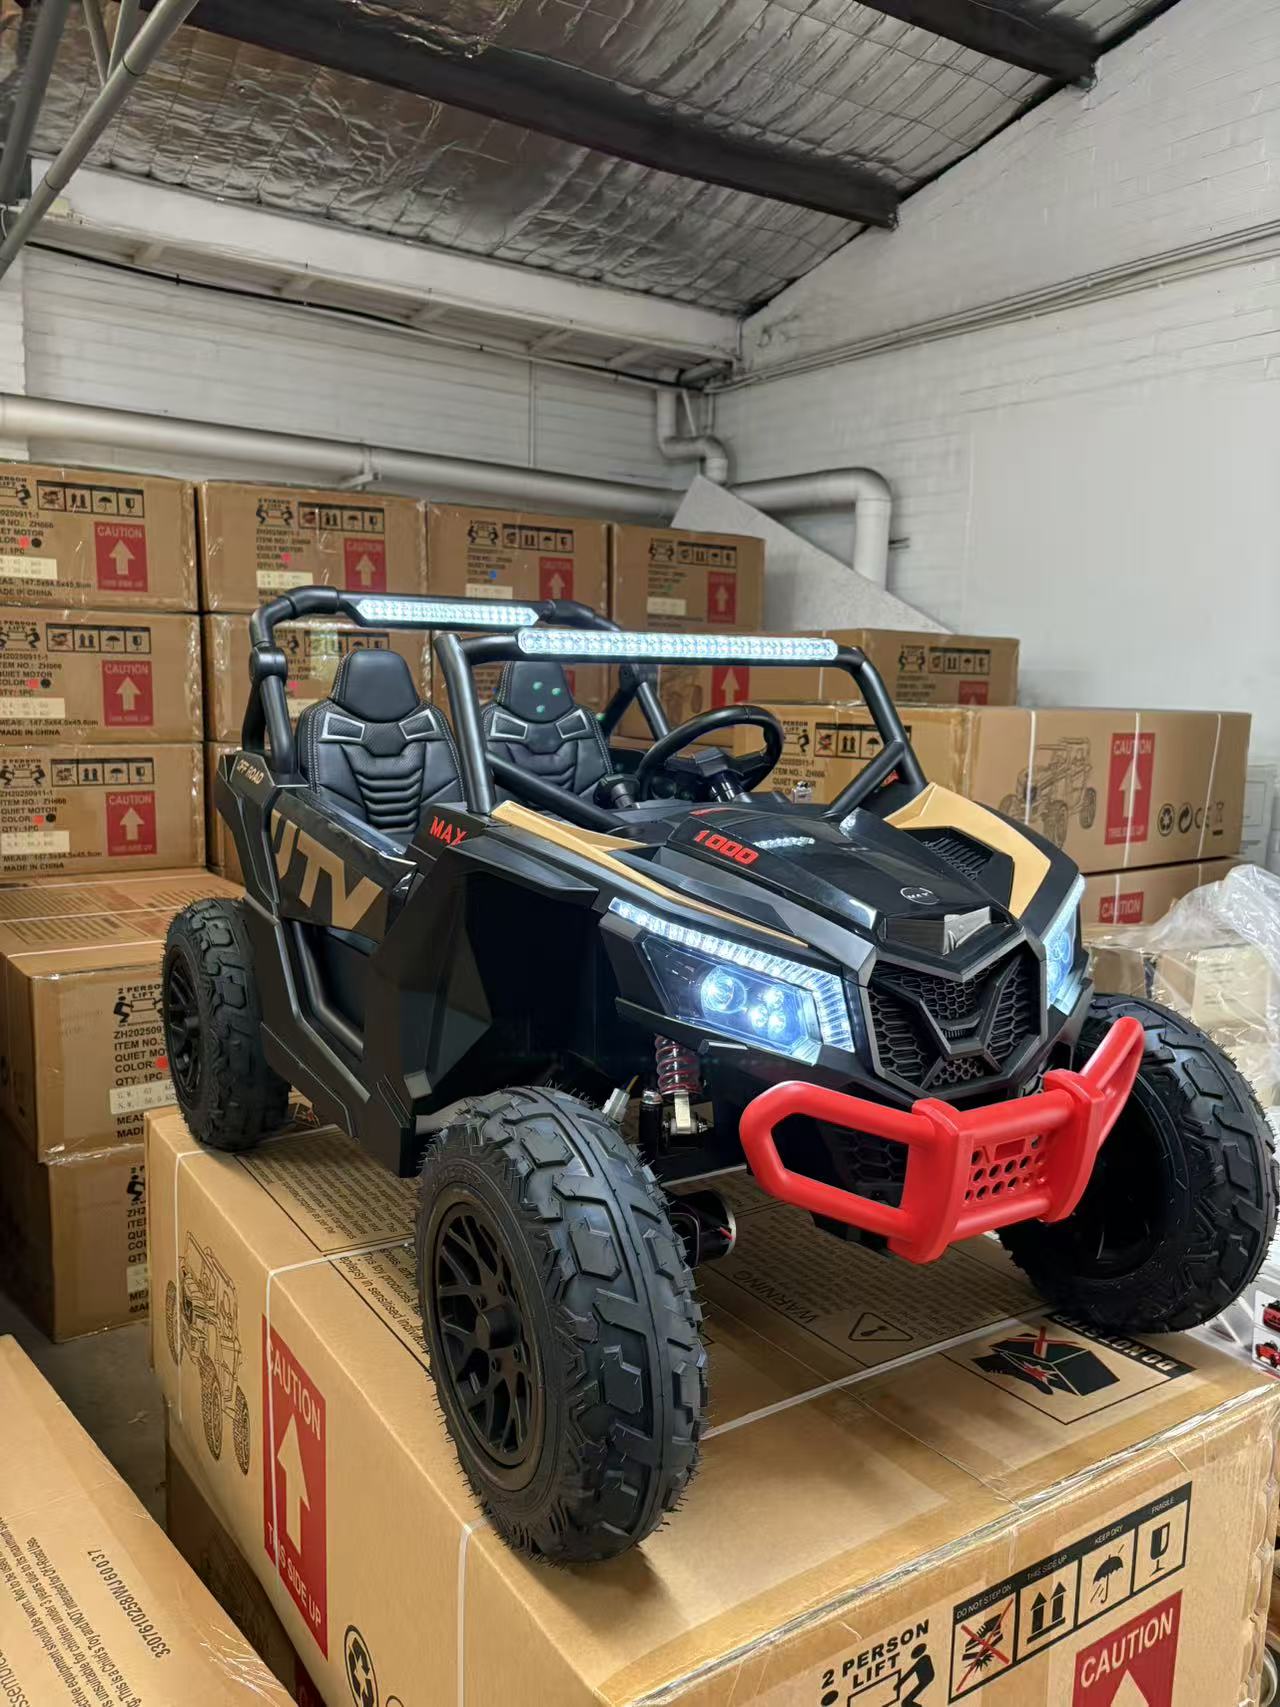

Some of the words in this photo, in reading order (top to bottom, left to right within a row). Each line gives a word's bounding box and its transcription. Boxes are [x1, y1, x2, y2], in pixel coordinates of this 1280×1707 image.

[14, 529, 44, 537] MOTOR
[98, 527, 143, 539] CAUTION
[27, 589, 53, 597] CHINA
[105, 663, 149, 674] CAUTION
[1, 729, 23, 737] MADE
[25, 729, 34, 737] IN
[237, 759, 249, 772] OFF
[246, 766, 264, 784] ROAD
[1, 798, 20, 806] ITEM
[109, 794, 151, 805] CAUTION
[28, 806, 58, 814] MOTOR
[429, 816, 468, 847] MAX
[694, 830, 759, 866] 1000
[4, 864, 28, 872] MADE
[29, 863, 38, 871] IN
[39, 862, 64, 870] CHINA
[127, 983, 161, 994] PERSO
[132, 991, 154, 999] LIFT
[114, 1039, 139, 1051] ITEM
[115, 1051, 147, 1063] QUIET
[115, 1060, 156, 1074] COLOR:
[115, 1077, 141, 1088] QTY:
[143, 1071, 163, 1082] 1PC
[116, 1113, 145, 1126] MEAS
[339, 1256, 366, 1279] epilepsy
[362, 1277, 373, 1287] in
[368, 1286, 402, 1319] sensitised
[372, 1262, 384, 1274] toy
[379, 1272, 415, 1303] produces
[732, 1268, 817, 1322] WARNING
[1098, 1338, 1145, 1356] NOT
[1142, 1357, 1176, 1371] DO
[266, 1344, 321, 1442] CAUTION
[1152, 1497, 1174, 1513] FRAGILE
[1095, 1531, 1110, 1544] KEEP
[1109, 1525, 1123, 1536] DRY
[16, 1556, 27, 1567] its
[1043, 1559, 1059, 1572] SIDE
[1058, 1554, 1067, 1564] UP
[5, 1572, 17, 1583] be
[25, 1571, 39, 1583] due
[48, 1575, 62, 1588] for
[12, 1587, 27, 1601] Not
[32, 1582, 52, 1601] years
[55, 1583, 77, 1613] intended
[287, 1557, 307, 1609] SIDE
[308, 1594, 322, 1628] UP
[39, 1600, 52, 1608] 3
[952, 1608, 967, 1619] DO
[968, 1599, 982, 1612] NOT
[1002, 1584, 1011, 1594] ON
[31, 1617, 43, 1628] be
[45, 1605, 63, 1624] under
[67, 1609, 86, 1627] NOT
[76, 1622, 94, 1636] and
[33, 1626, 56, 1650] should
[57, 1624, 79, 1652] children
[86, 1633, 101, 1650] Toy
[821, 1668, 835, 1690] 2
[842, 1618, 930, 1681] PERSON
[1080, 1607, 1174, 1689] CAUTION
[72, 1651, 86, 1664] for
[92, 1647, 115, 1672] Child's
[48, 1649, 78, 1688] equipment
[852, 1651, 900, 1690] LIFT
[79, 1662, 109, 1701] unsuitable
[110, 1673, 123, 1685] is
[115, 1682, 133, 1701] This
